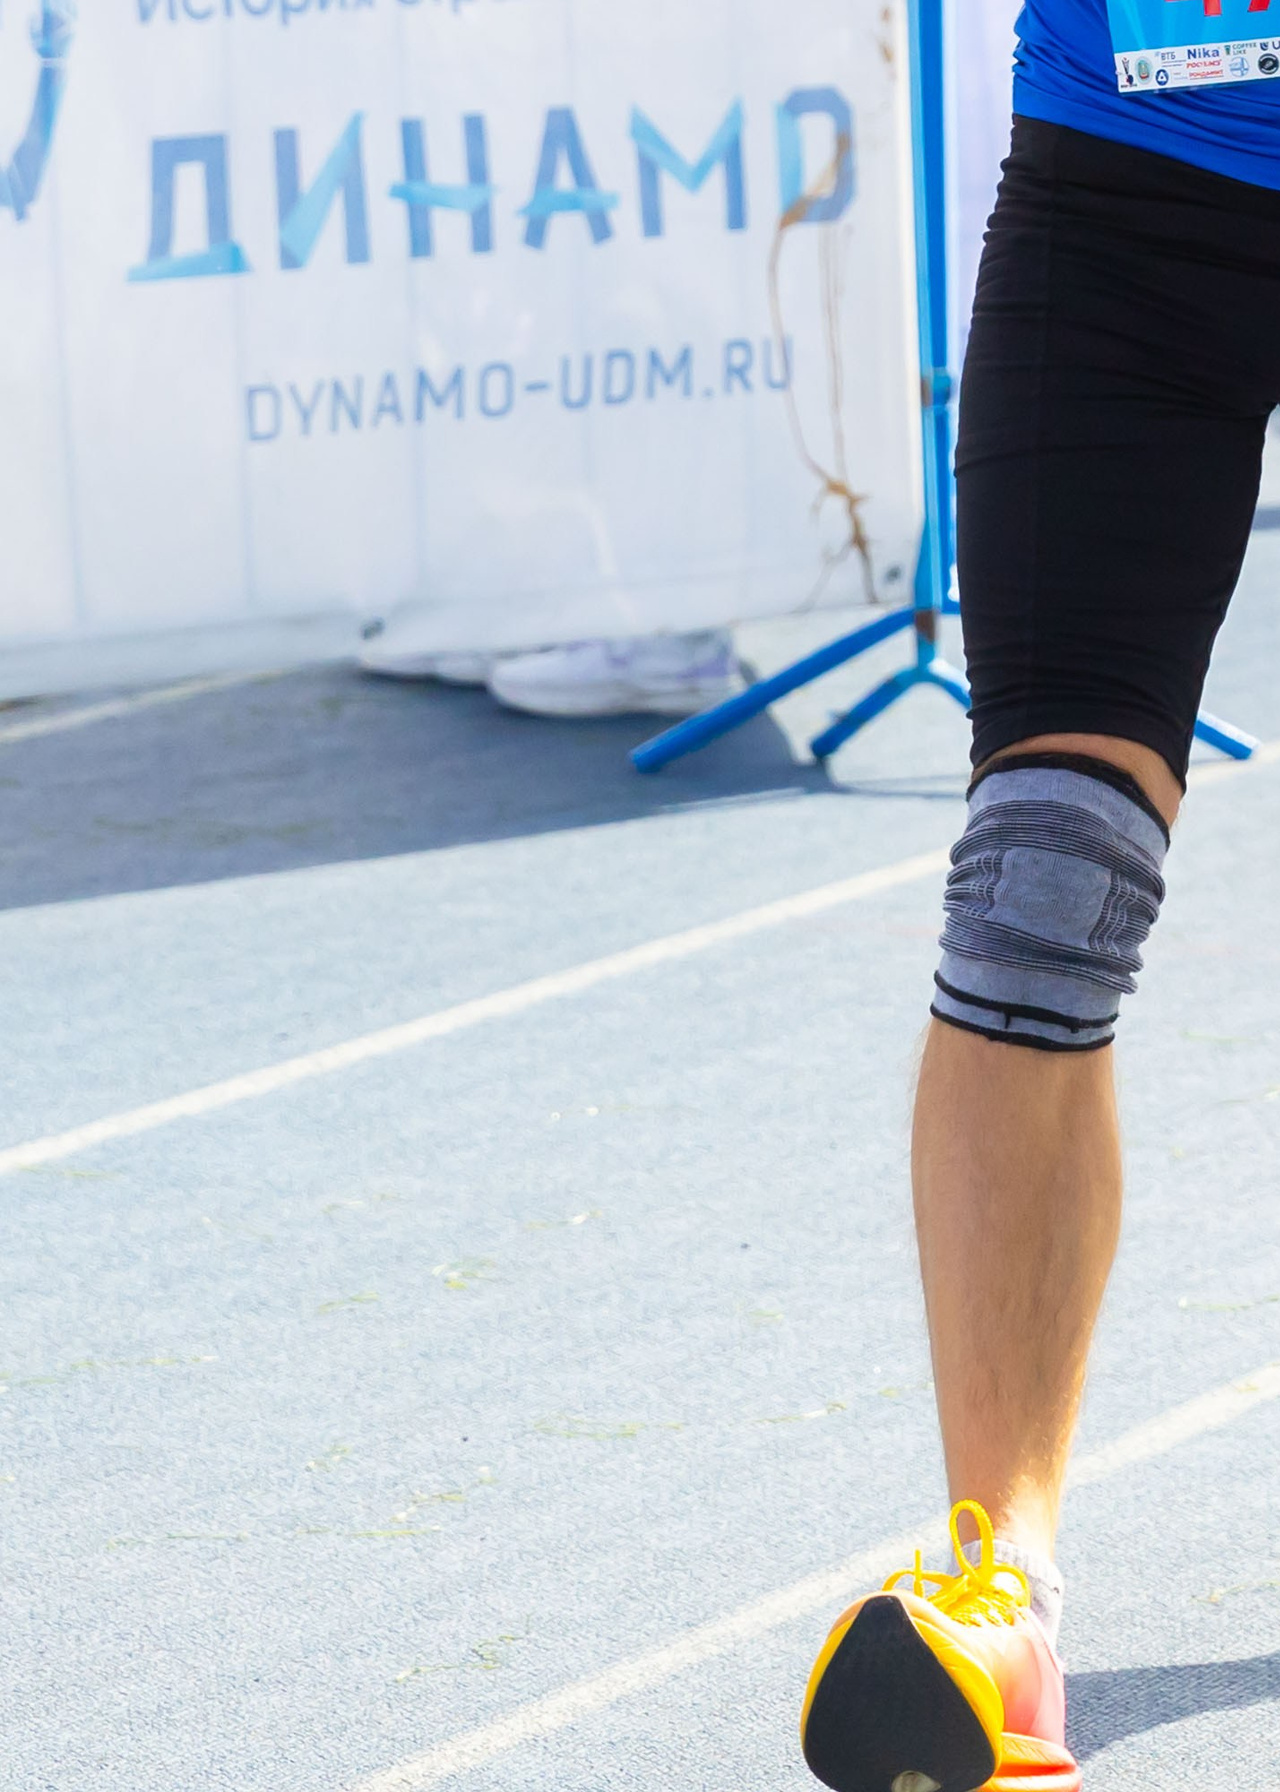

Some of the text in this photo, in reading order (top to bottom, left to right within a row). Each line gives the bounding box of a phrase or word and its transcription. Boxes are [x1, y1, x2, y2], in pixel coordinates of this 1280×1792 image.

[1187, 48, 1220, 60] Nika
[126, 85, 858, 284] ДИНАМО
[245, 335, 796, 444] DYNAMO-UDM.RU
